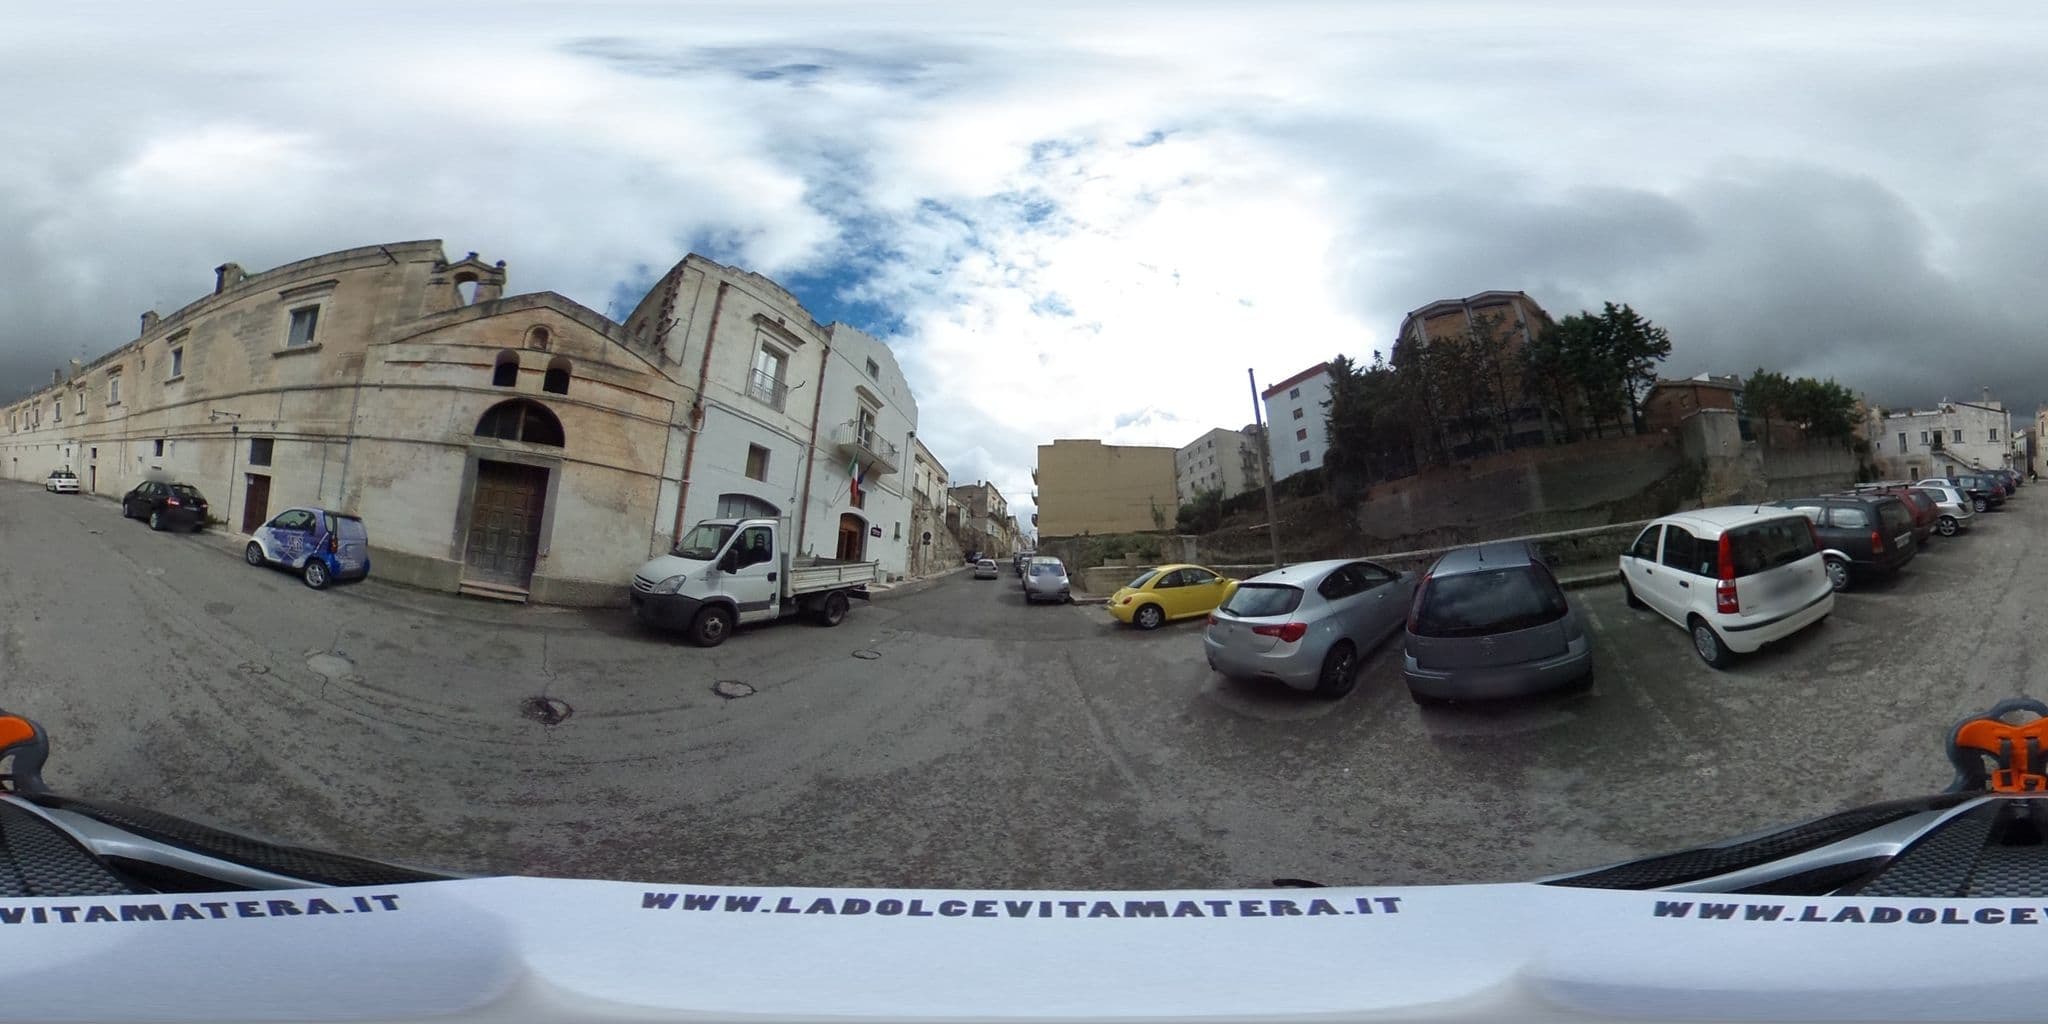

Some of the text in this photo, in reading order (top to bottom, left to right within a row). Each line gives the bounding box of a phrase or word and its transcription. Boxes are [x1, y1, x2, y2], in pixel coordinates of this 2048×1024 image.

[0, 894, 400, 924] VITAMATERA.IT
[642, 891, 1401, 918] WWW.LADOLCEVITAMATERA.IT
[1653, 900, 2048, 925] WWW.LADOLCE
